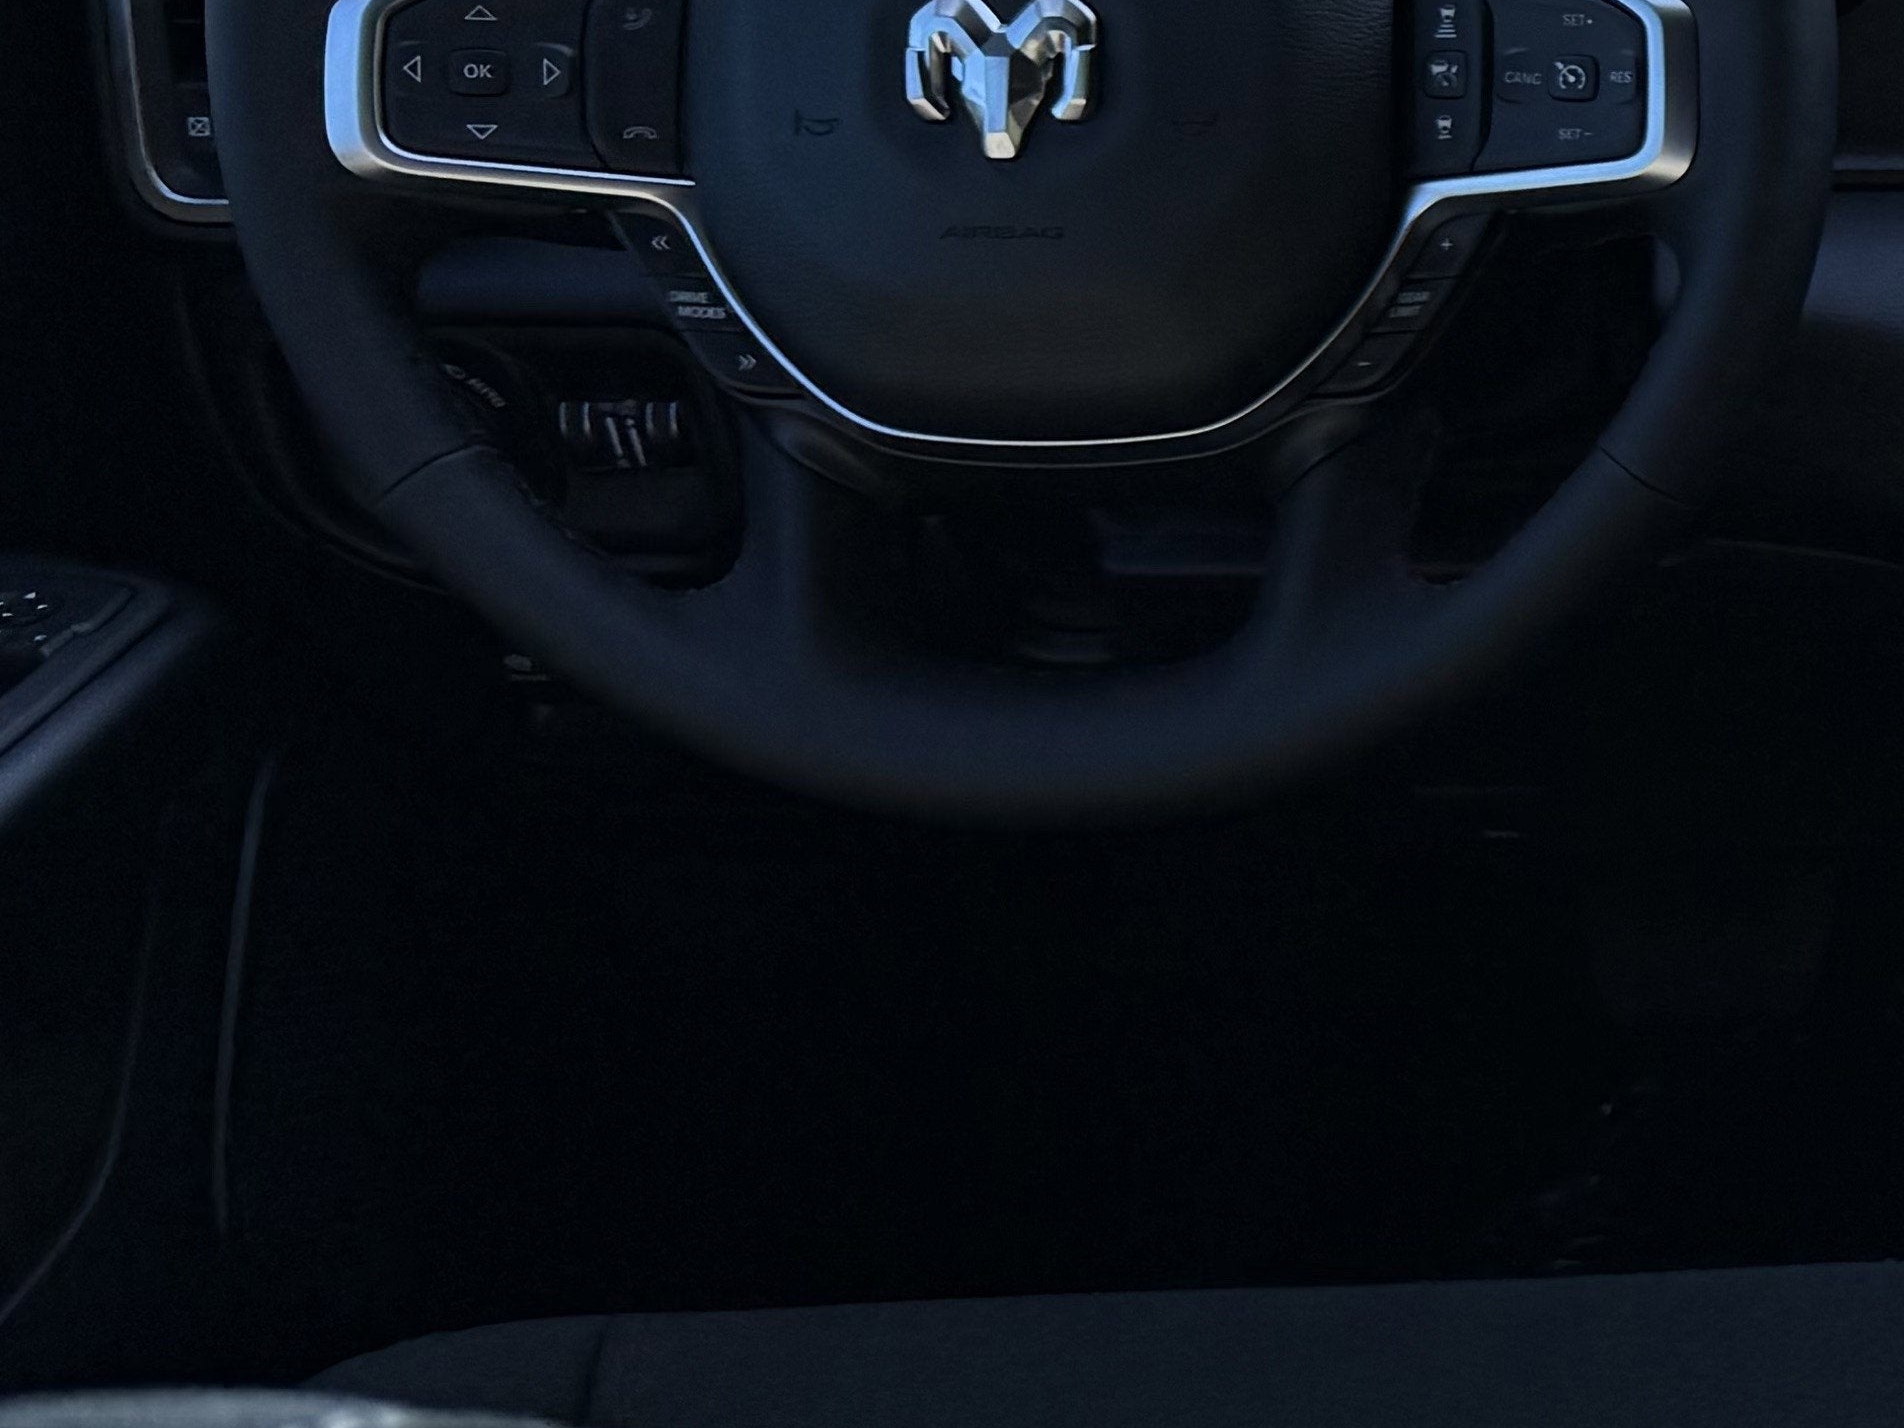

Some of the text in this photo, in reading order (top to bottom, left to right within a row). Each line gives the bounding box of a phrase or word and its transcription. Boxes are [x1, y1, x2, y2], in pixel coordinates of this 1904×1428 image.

[463, 63, 493, 79] OK
[1610, 72, 1634, 83] RES
[1504, 72, 1542, 85] CANC
[939, 225, 1064, 240] AIRBAG
